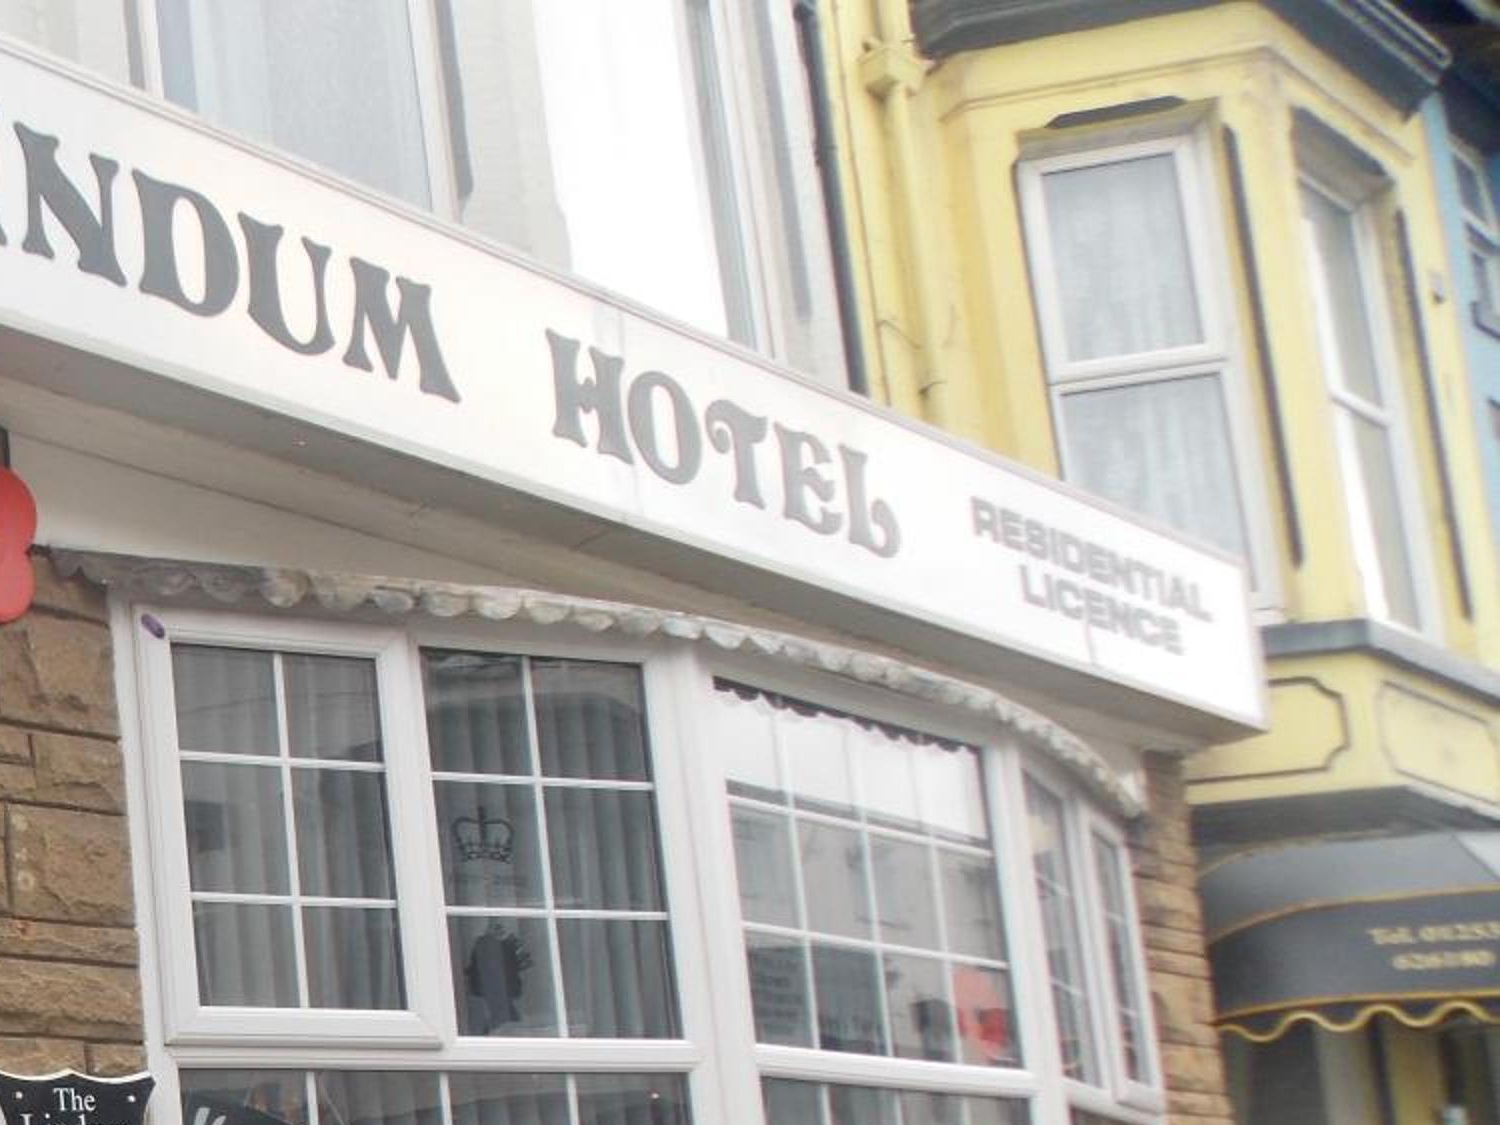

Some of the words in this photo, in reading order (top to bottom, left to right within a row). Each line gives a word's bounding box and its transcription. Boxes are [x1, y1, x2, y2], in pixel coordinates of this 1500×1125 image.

[545, 327, 900, 560] HOTEL
[970, 495, 1214, 623] RESIDENTIAL
[1018, 563, 1184, 657] LICENCE
[53, 1087, 96, 1112] The
